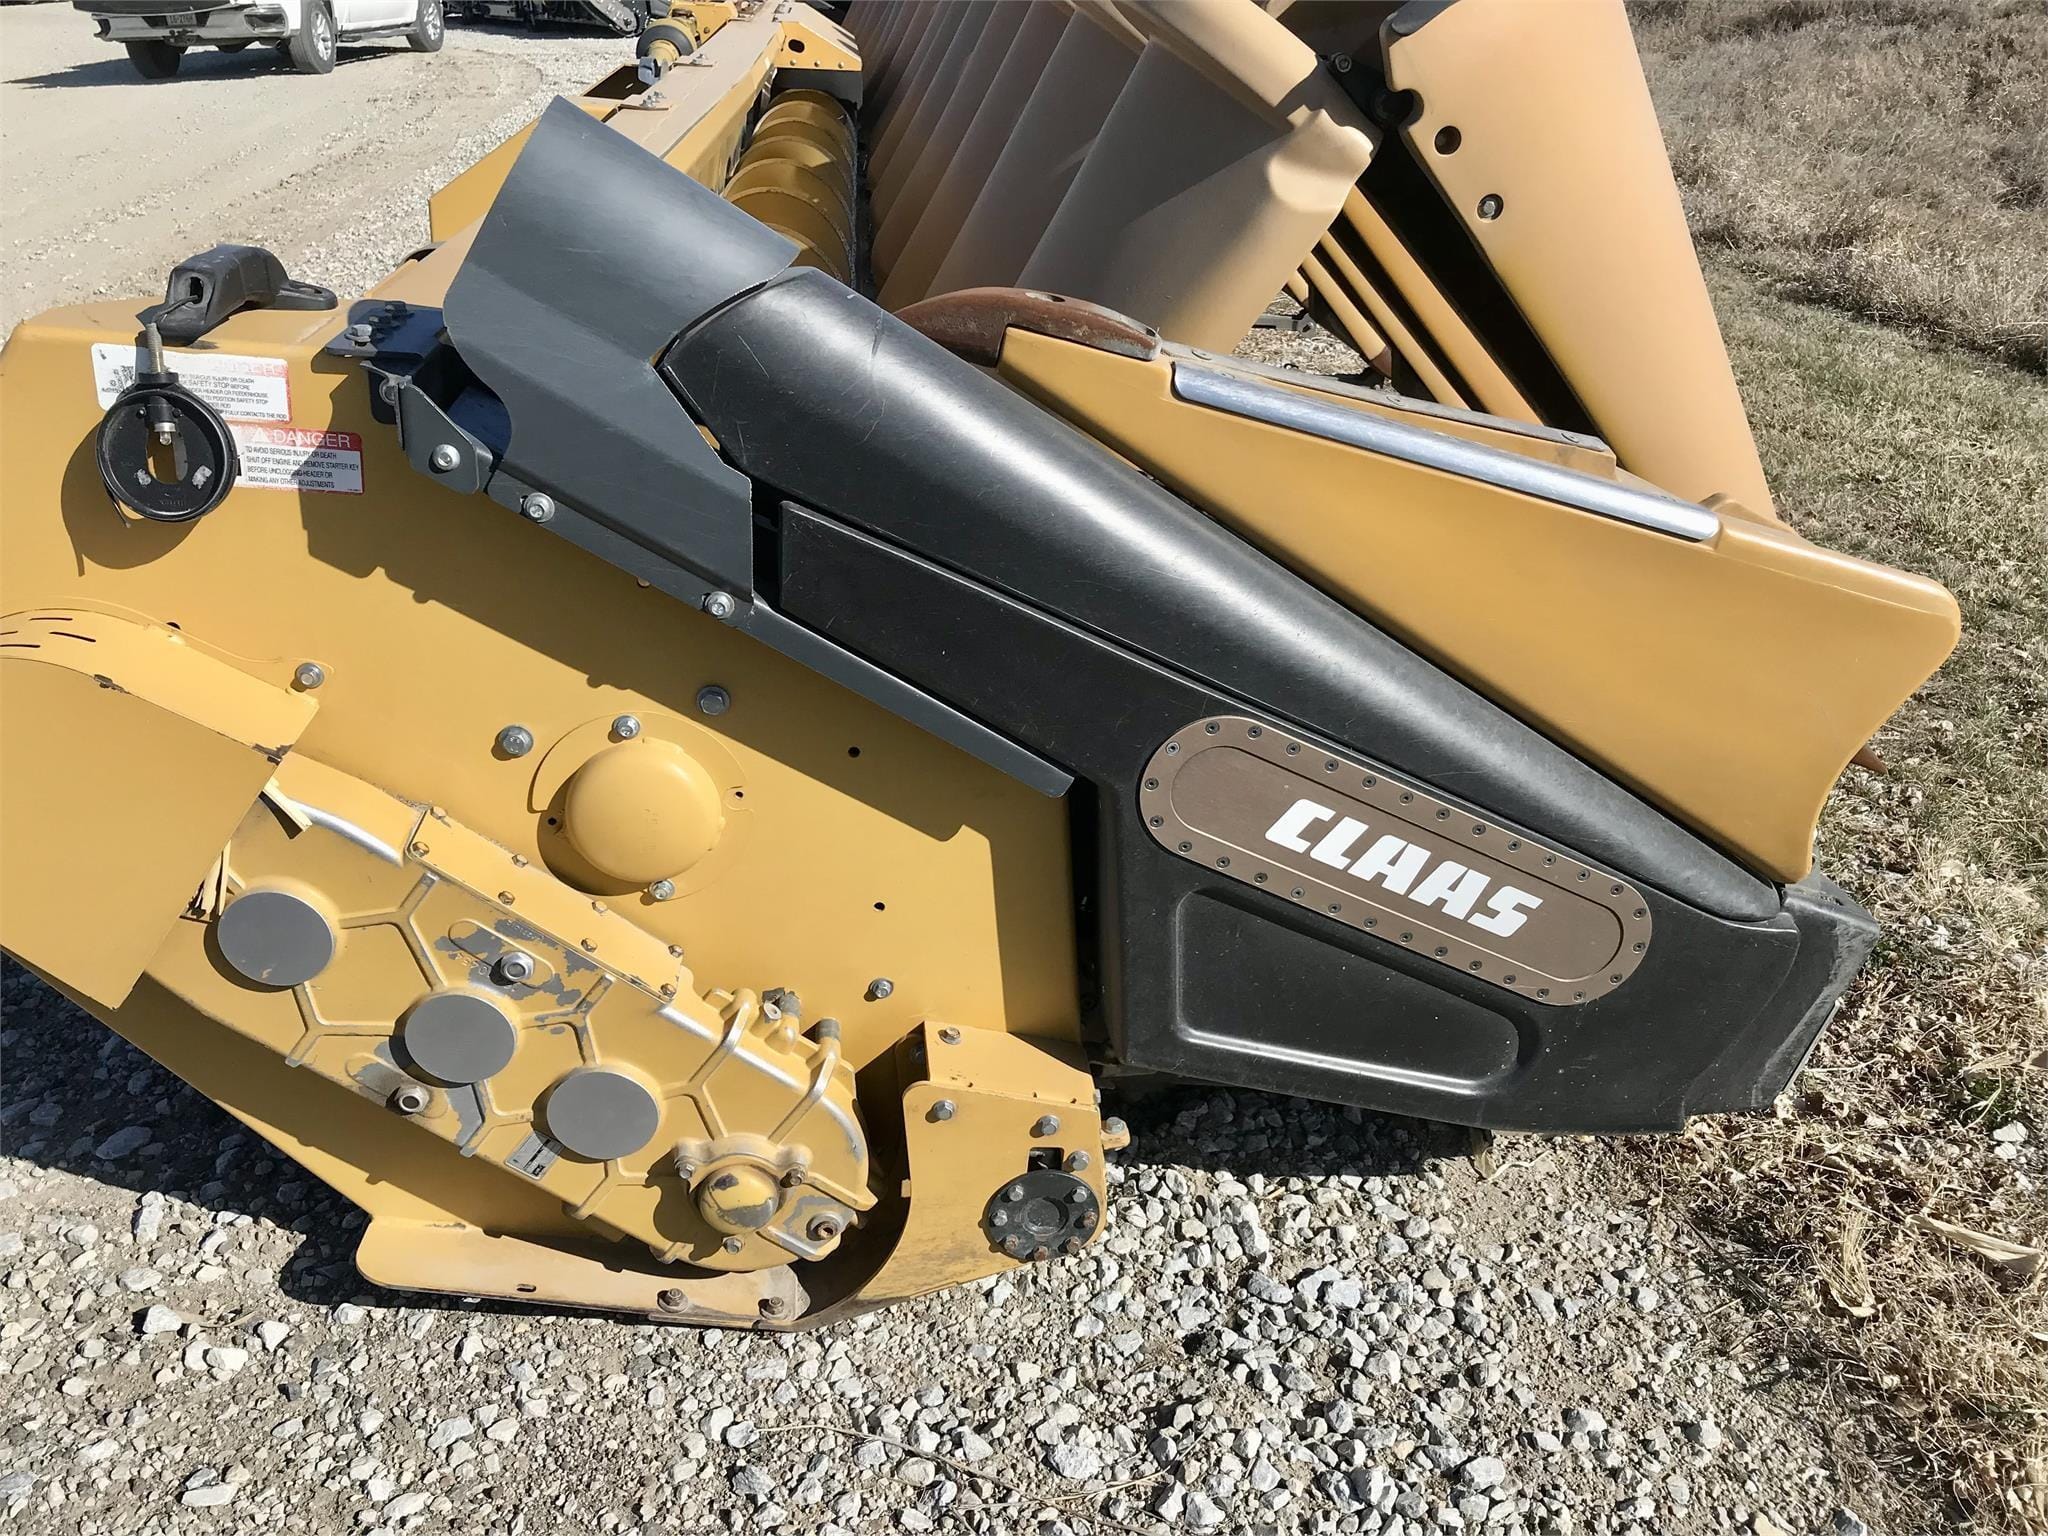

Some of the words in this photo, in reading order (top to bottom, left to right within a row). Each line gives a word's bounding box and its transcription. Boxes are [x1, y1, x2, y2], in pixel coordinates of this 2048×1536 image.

[189, 380, 212, 388] SAFETY
[236, 397, 256, 405] SAFETY
[256, 398, 269, 406] STOP
[225, 409, 240, 417] FULLY
[240, 410, 266, 419] CONTACTS
[272, 429, 351, 449] DANGER
[253, 446, 269, 455] AVOID
[269, 447, 292, 456] SERIOUS
[293, 449, 311, 457] INJURY
[320, 451, 337, 460] DEATH
[246, 455, 260, 464] SHUT
[261, 456, 271, 464] OFF
[272, 457, 291, 466] ENGINE
[292, 459, 303, 467] AND
[303, 460, 325, 470] REMOVE
[325, 461, 349, 471] STARTER
[349, 462, 360, 472] KEY
[247, 465, 268, 474] BEFORE
[303, 469, 324, 479] HEADER
[280, 477, 298, 486] OTHER
[298, 479, 336, 489] ADJUSTMENTS
[1265, 798, 1544, 938] CLAAS
